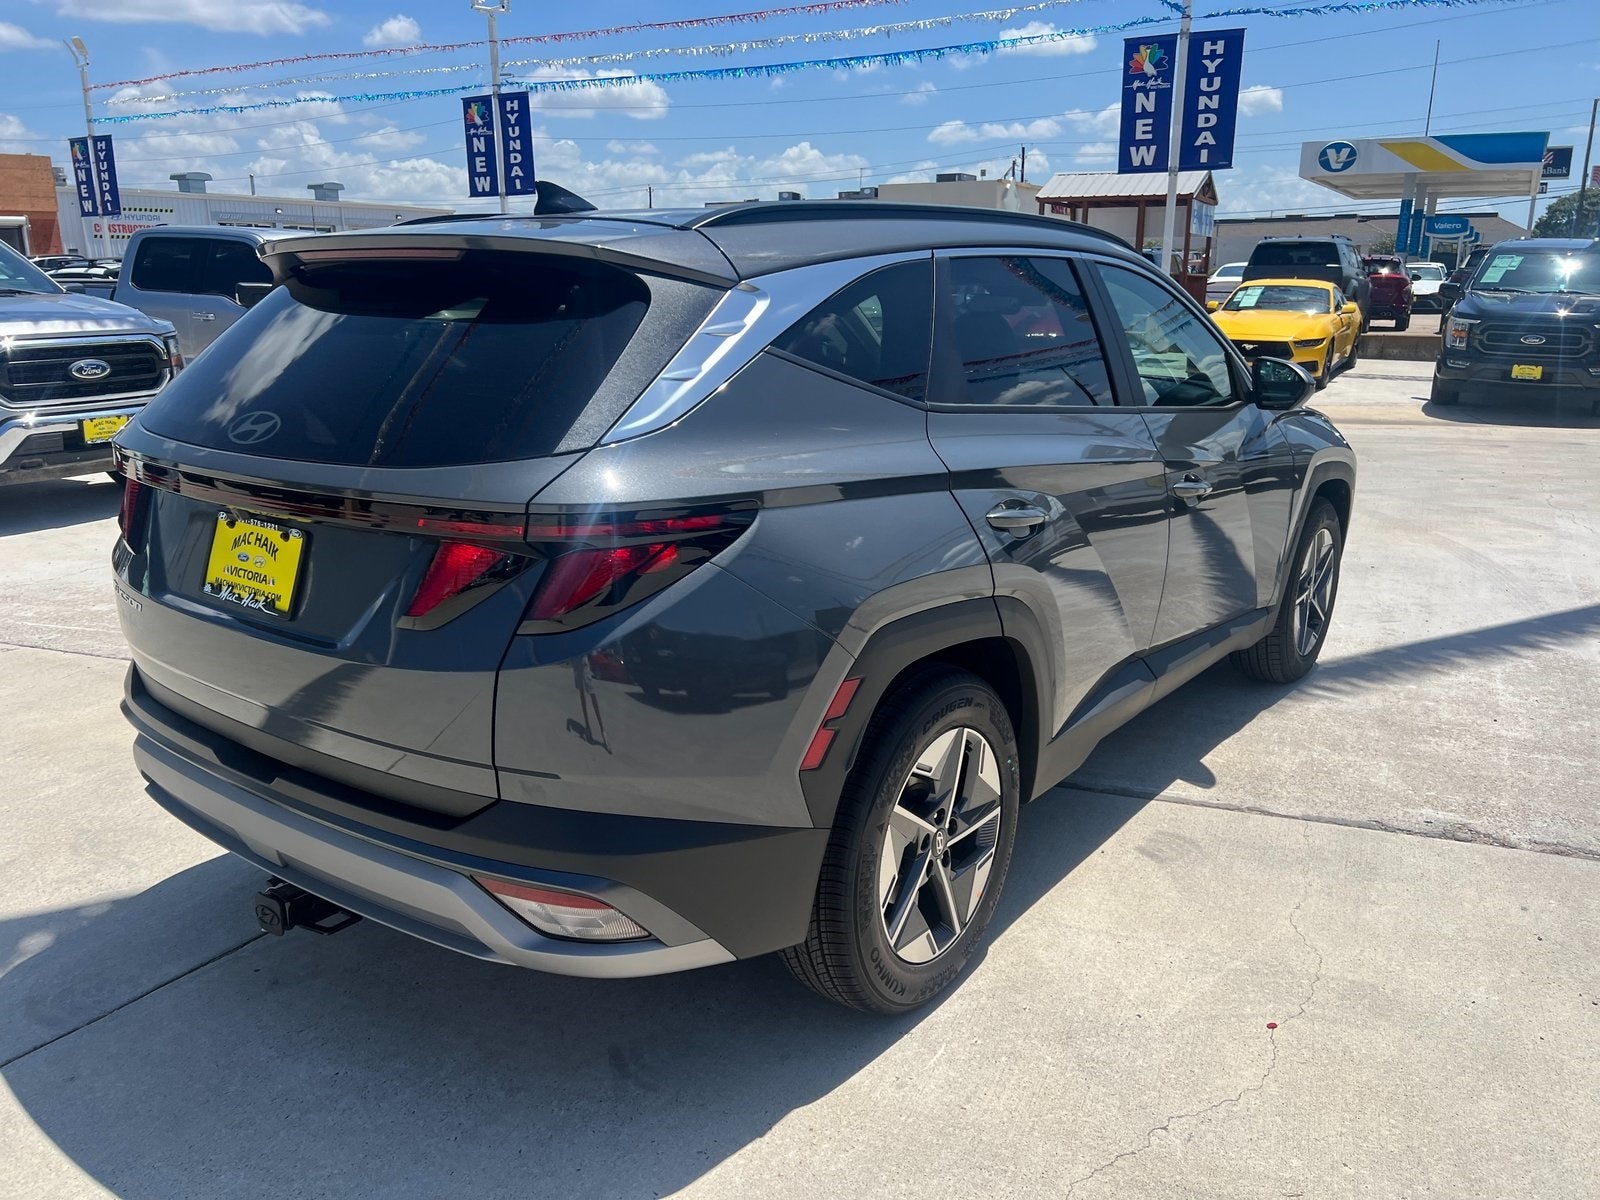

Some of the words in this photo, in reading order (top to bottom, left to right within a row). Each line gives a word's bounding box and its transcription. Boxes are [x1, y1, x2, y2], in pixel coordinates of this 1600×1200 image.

[1194, 40, 1225, 163] HYUNDAI
[506, 99, 524, 190] HYUNDAI
[1129, 91, 1157, 167] NEW
[97, 141, 112, 211] HYUNDAI
[473, 137, 491, 192] NEW
[78, 169, 93, 213] NEW
[81, 364, 102, 375] Ford
[231, 531, 252, 552] MAC
[254, 532, 280, 562] HAIK
[214, 586, 240, 604] Mac
[240, 593, 272, 612] Haik
[230, 565, 268, 586] VICTORIA
[870, 947, 907, 997] KUMHO
